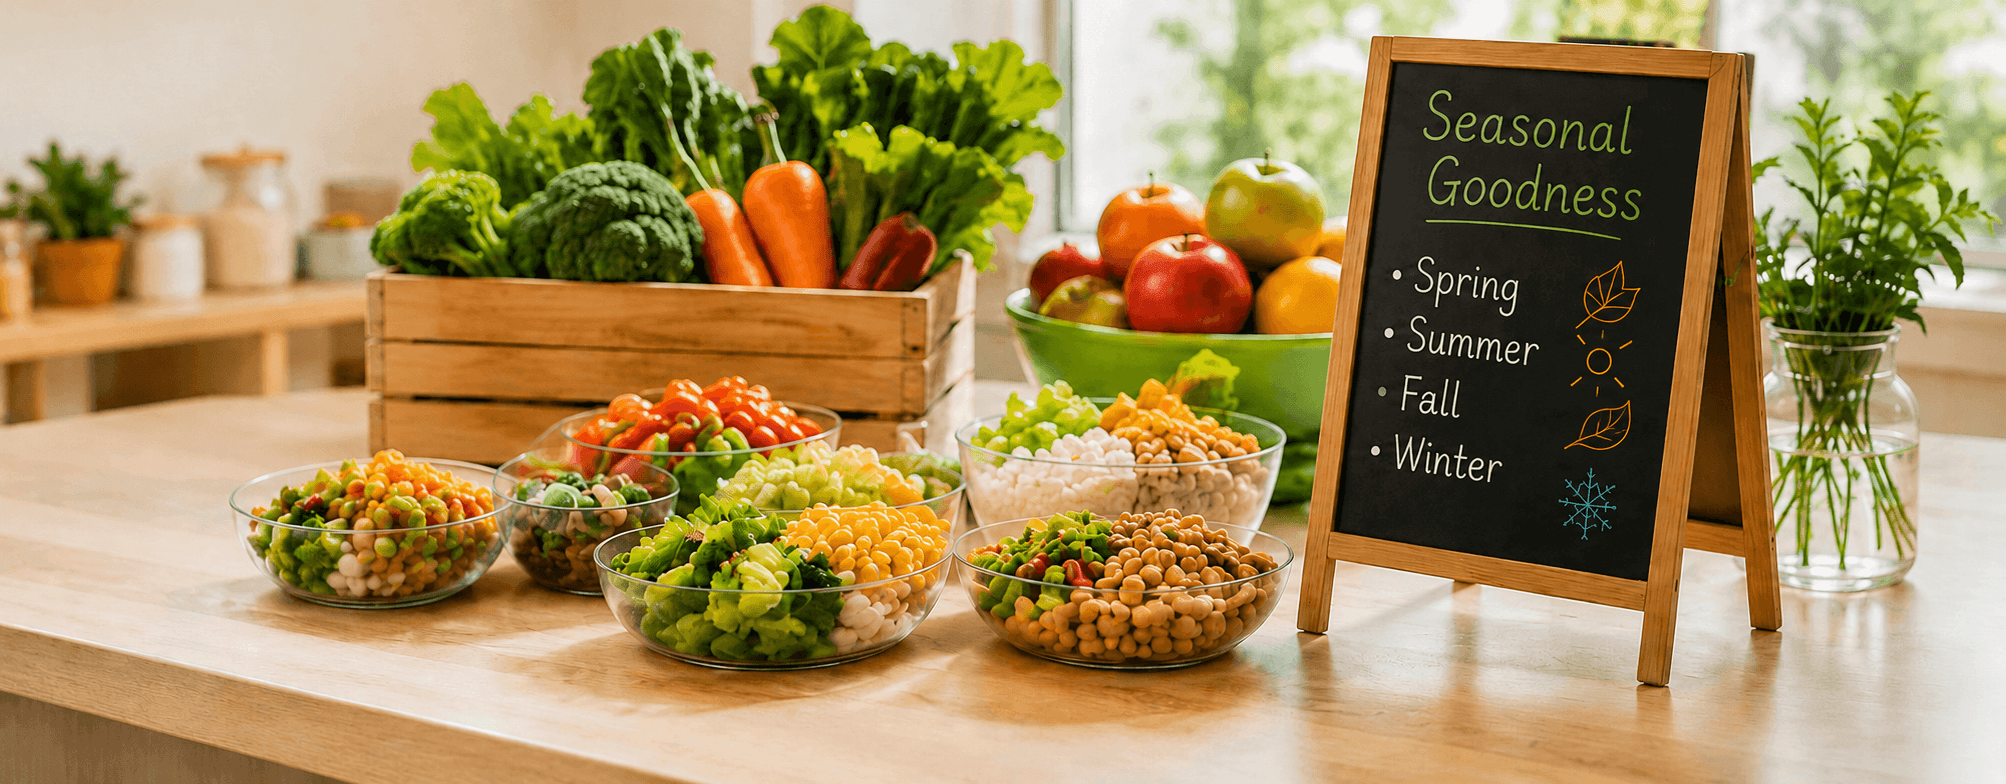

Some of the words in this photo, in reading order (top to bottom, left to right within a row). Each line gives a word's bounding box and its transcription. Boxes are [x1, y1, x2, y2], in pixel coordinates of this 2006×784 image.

[1423, 90, 1631, 154] Seasonal
[1428, 156, 1641, 220] Goodness
[1415, 256, 1518, 316] Spring
[1407, 316, 1539, 365] Summer
[1401, 375, 1459, 418] Fall
[1395, 434, 1502, 482] Winter
